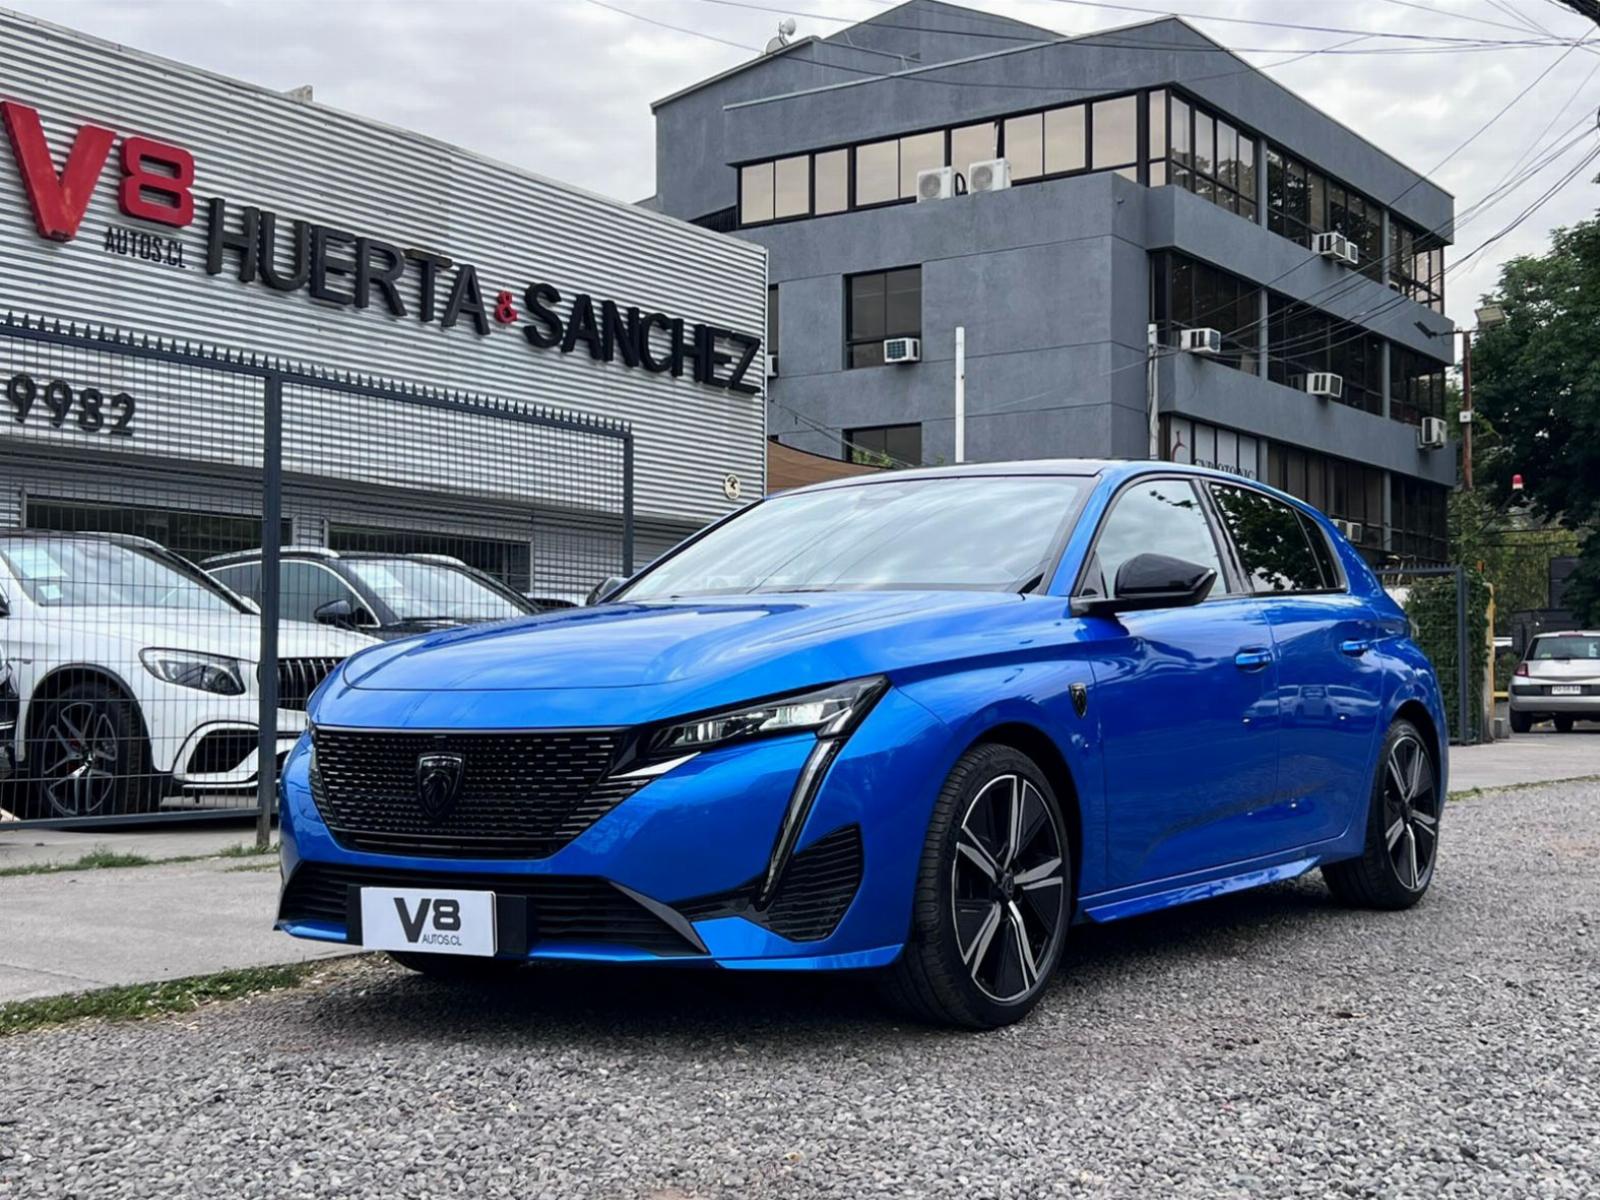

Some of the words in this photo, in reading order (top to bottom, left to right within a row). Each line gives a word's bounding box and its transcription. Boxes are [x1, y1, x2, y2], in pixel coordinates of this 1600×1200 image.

[0, 100, 195, 242] V8
[104, 226, 186, 268] AUTOS.CL
[206, 197, 490, 335] HUERTA
[494, 290, 518, 324] &
[523, 283, 761, 394] SANCHEZ
[7, 373, 136, 436] 9982
[393, 897, 461, 943] V8
[421, 934, 462, 946] AUTOS.CL
